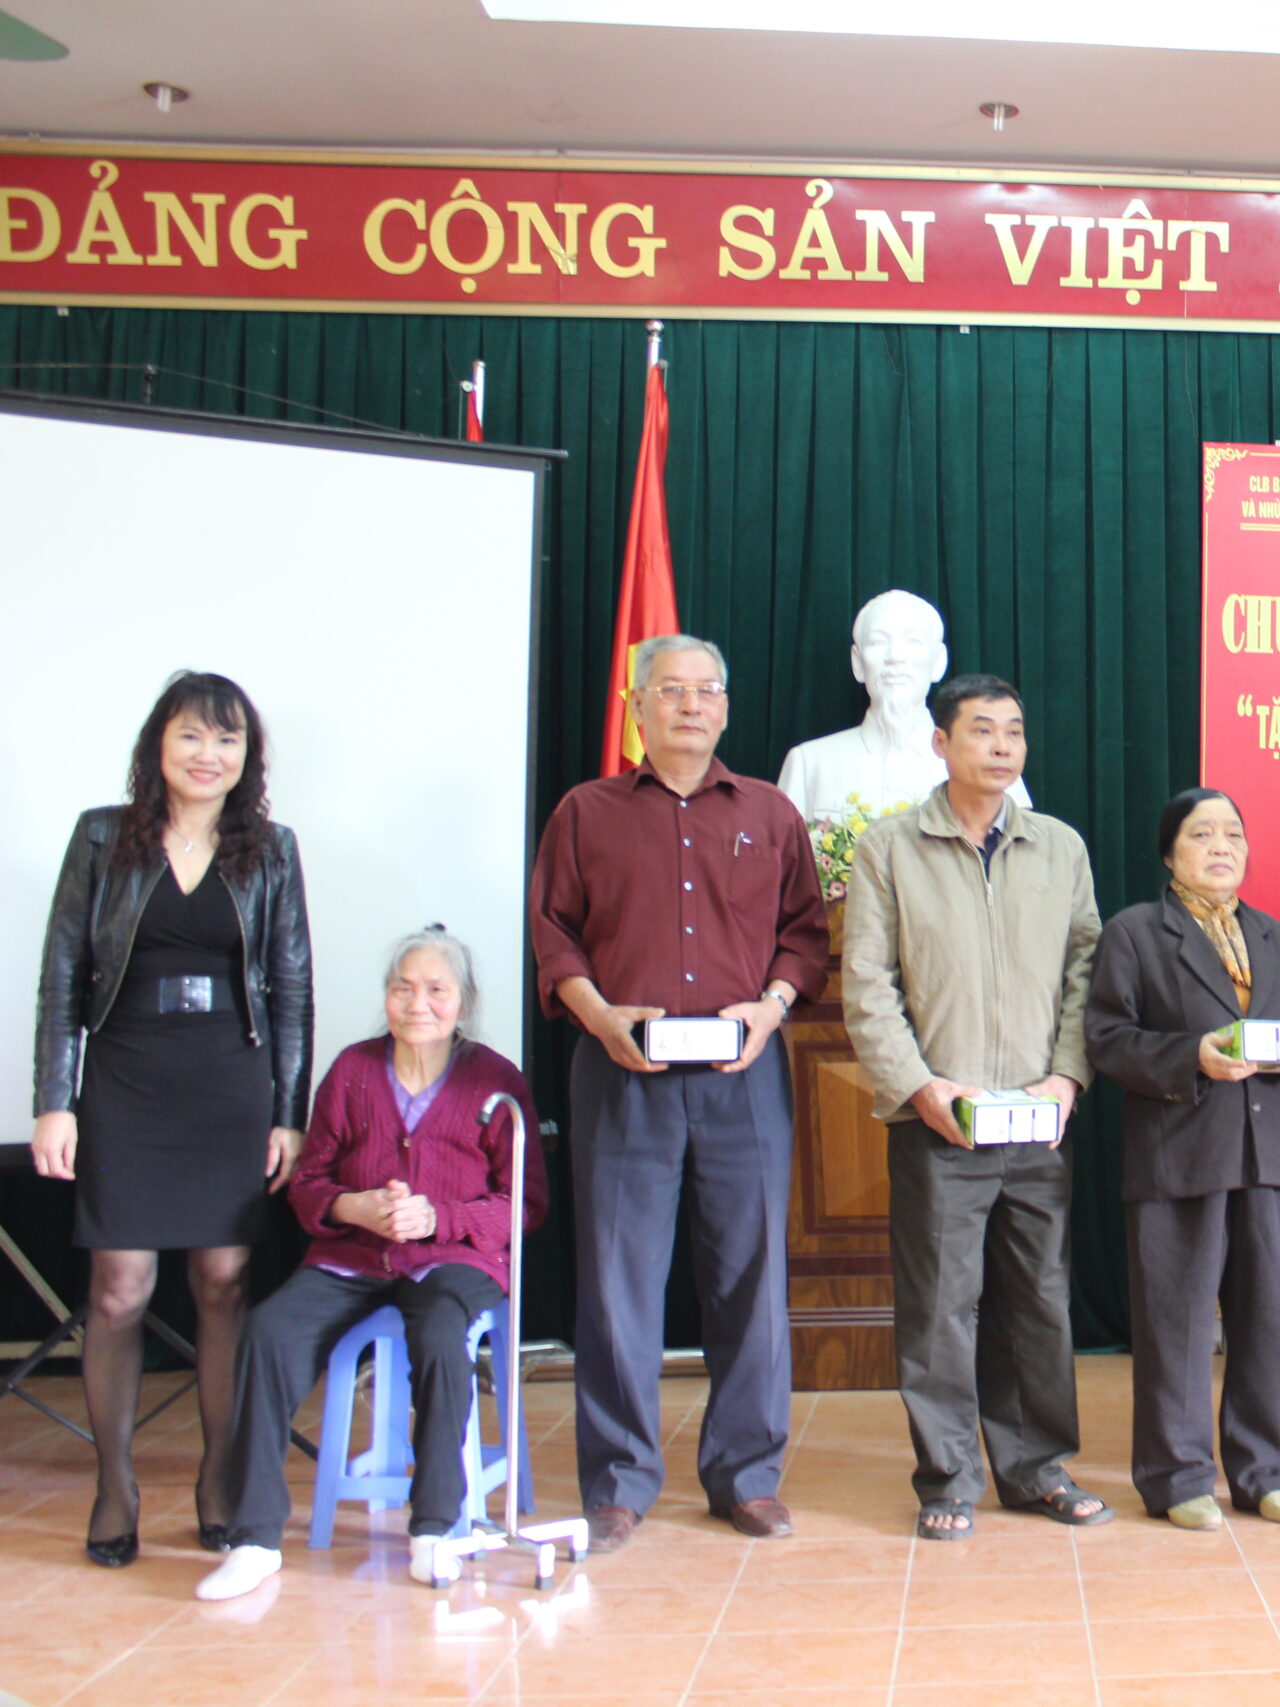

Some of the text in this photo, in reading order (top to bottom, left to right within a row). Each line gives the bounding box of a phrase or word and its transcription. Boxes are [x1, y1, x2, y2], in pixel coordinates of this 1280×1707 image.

[0, 160, 308, 271] ĐẢNG
[363, 178, 667, 294] CỘNG
[718, 178, 936, 283] SẢN
[984, 198, 1230, 305] VIỆT
[1249, 475, 1270, 493] CLB
